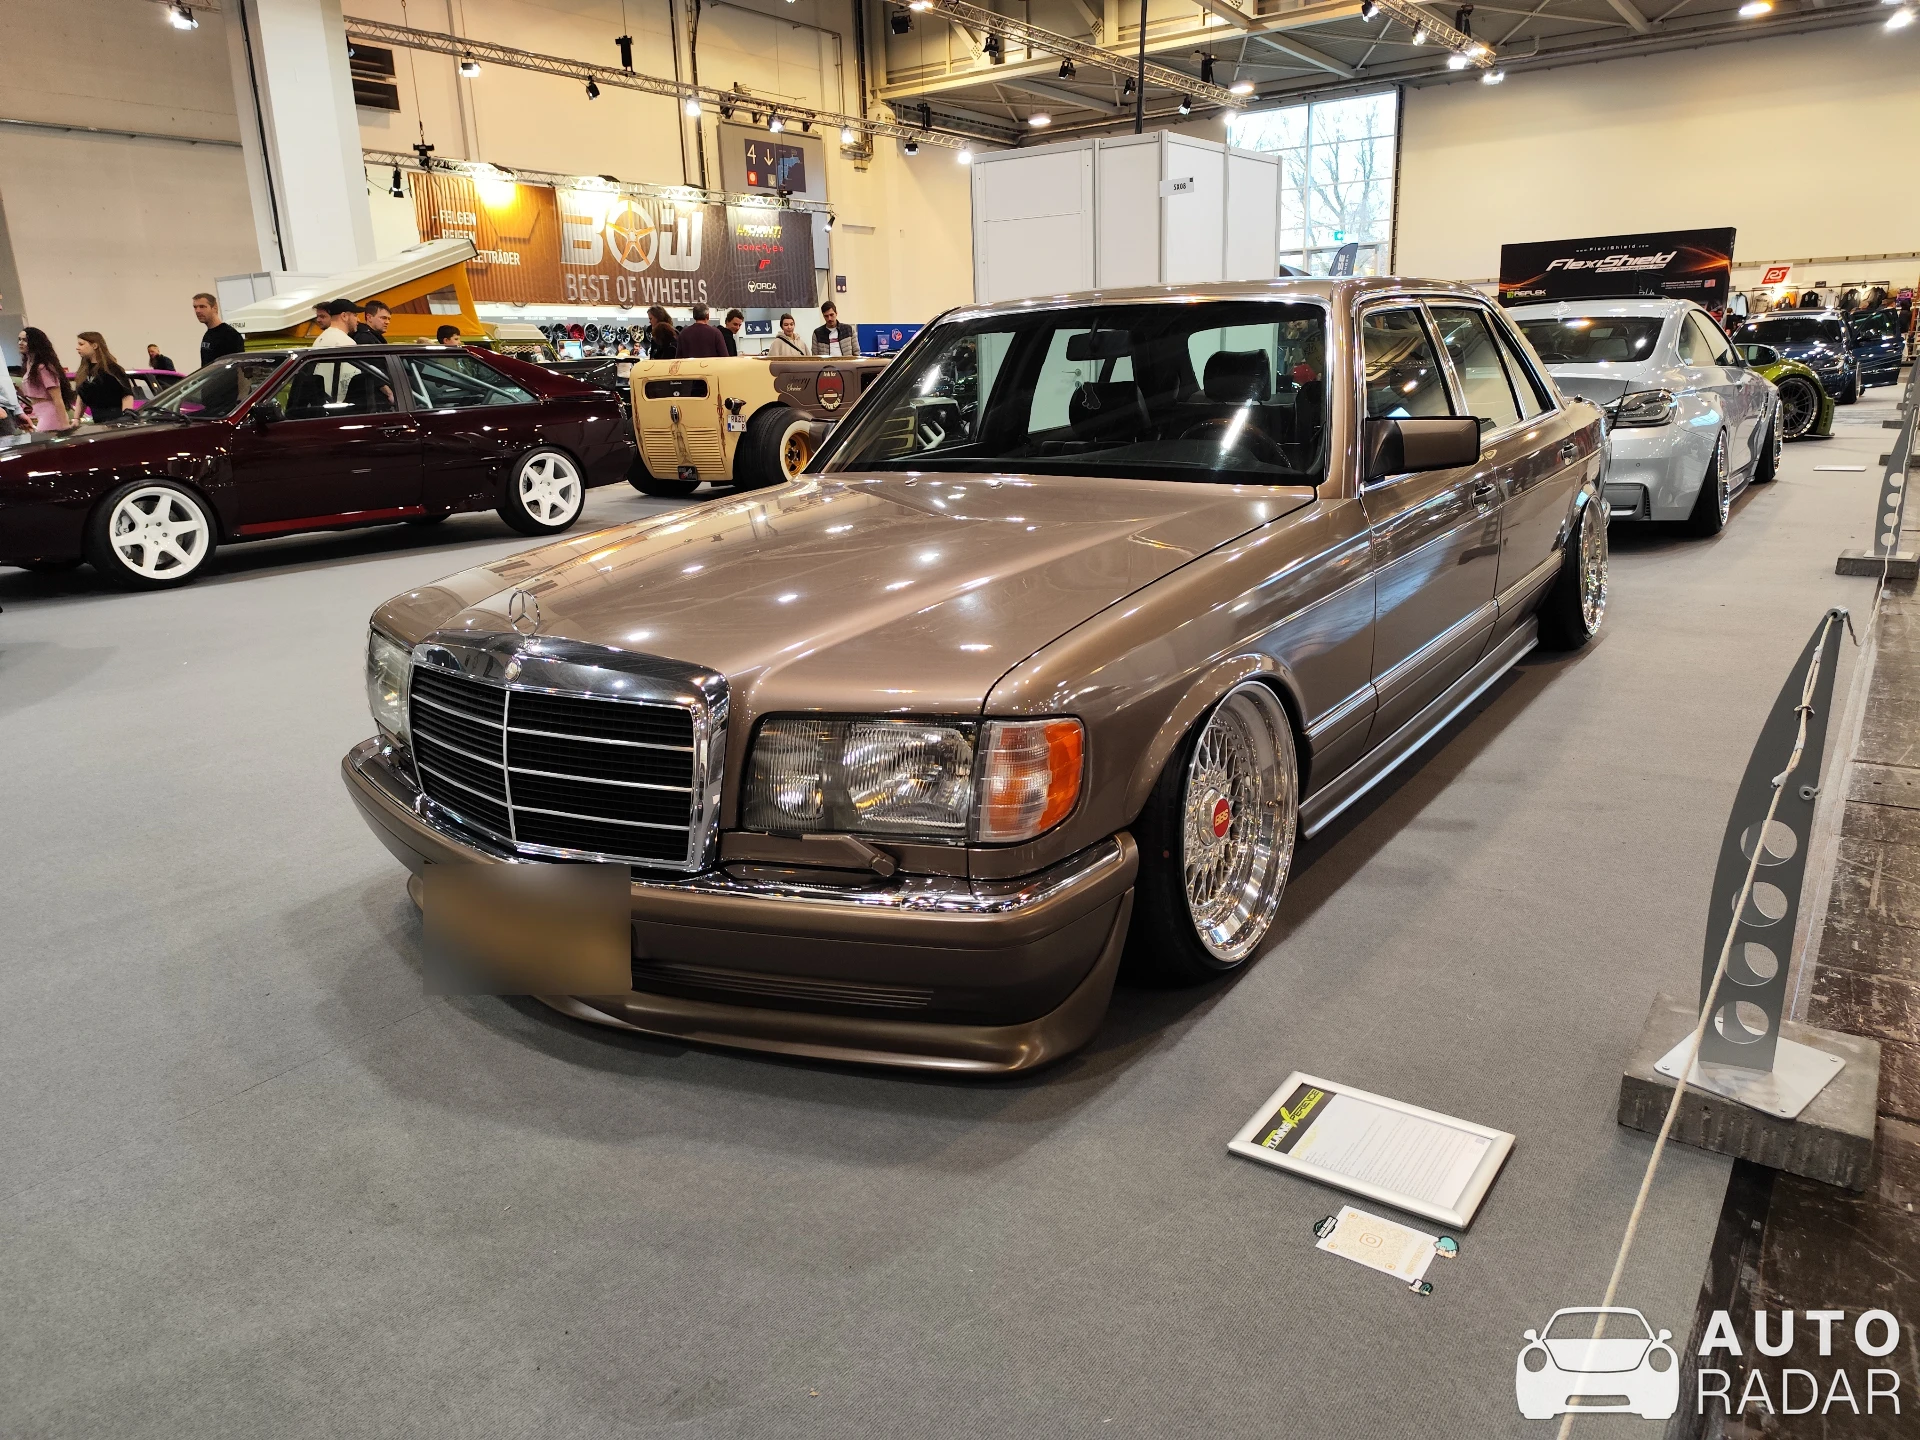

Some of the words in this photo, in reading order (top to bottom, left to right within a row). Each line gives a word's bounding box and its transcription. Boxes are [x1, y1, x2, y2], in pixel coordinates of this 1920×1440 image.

[747, 144, 757, 165] 4
[440, 210, 476, 226] FELGEN
[737, 243, 784, 254] CONCAVER
[1545, 251, 1678, 272] FlexiShield
[566, 273, 609, 301] BEST
[616, 275, 637, 303] OF
[640, 276, 708, 304] WHEELS
[755, 282, 777, 290] ORCA
[1514, 289, 1547, 297] REFLEK
[1214, 808, 1229, 828] BBS
